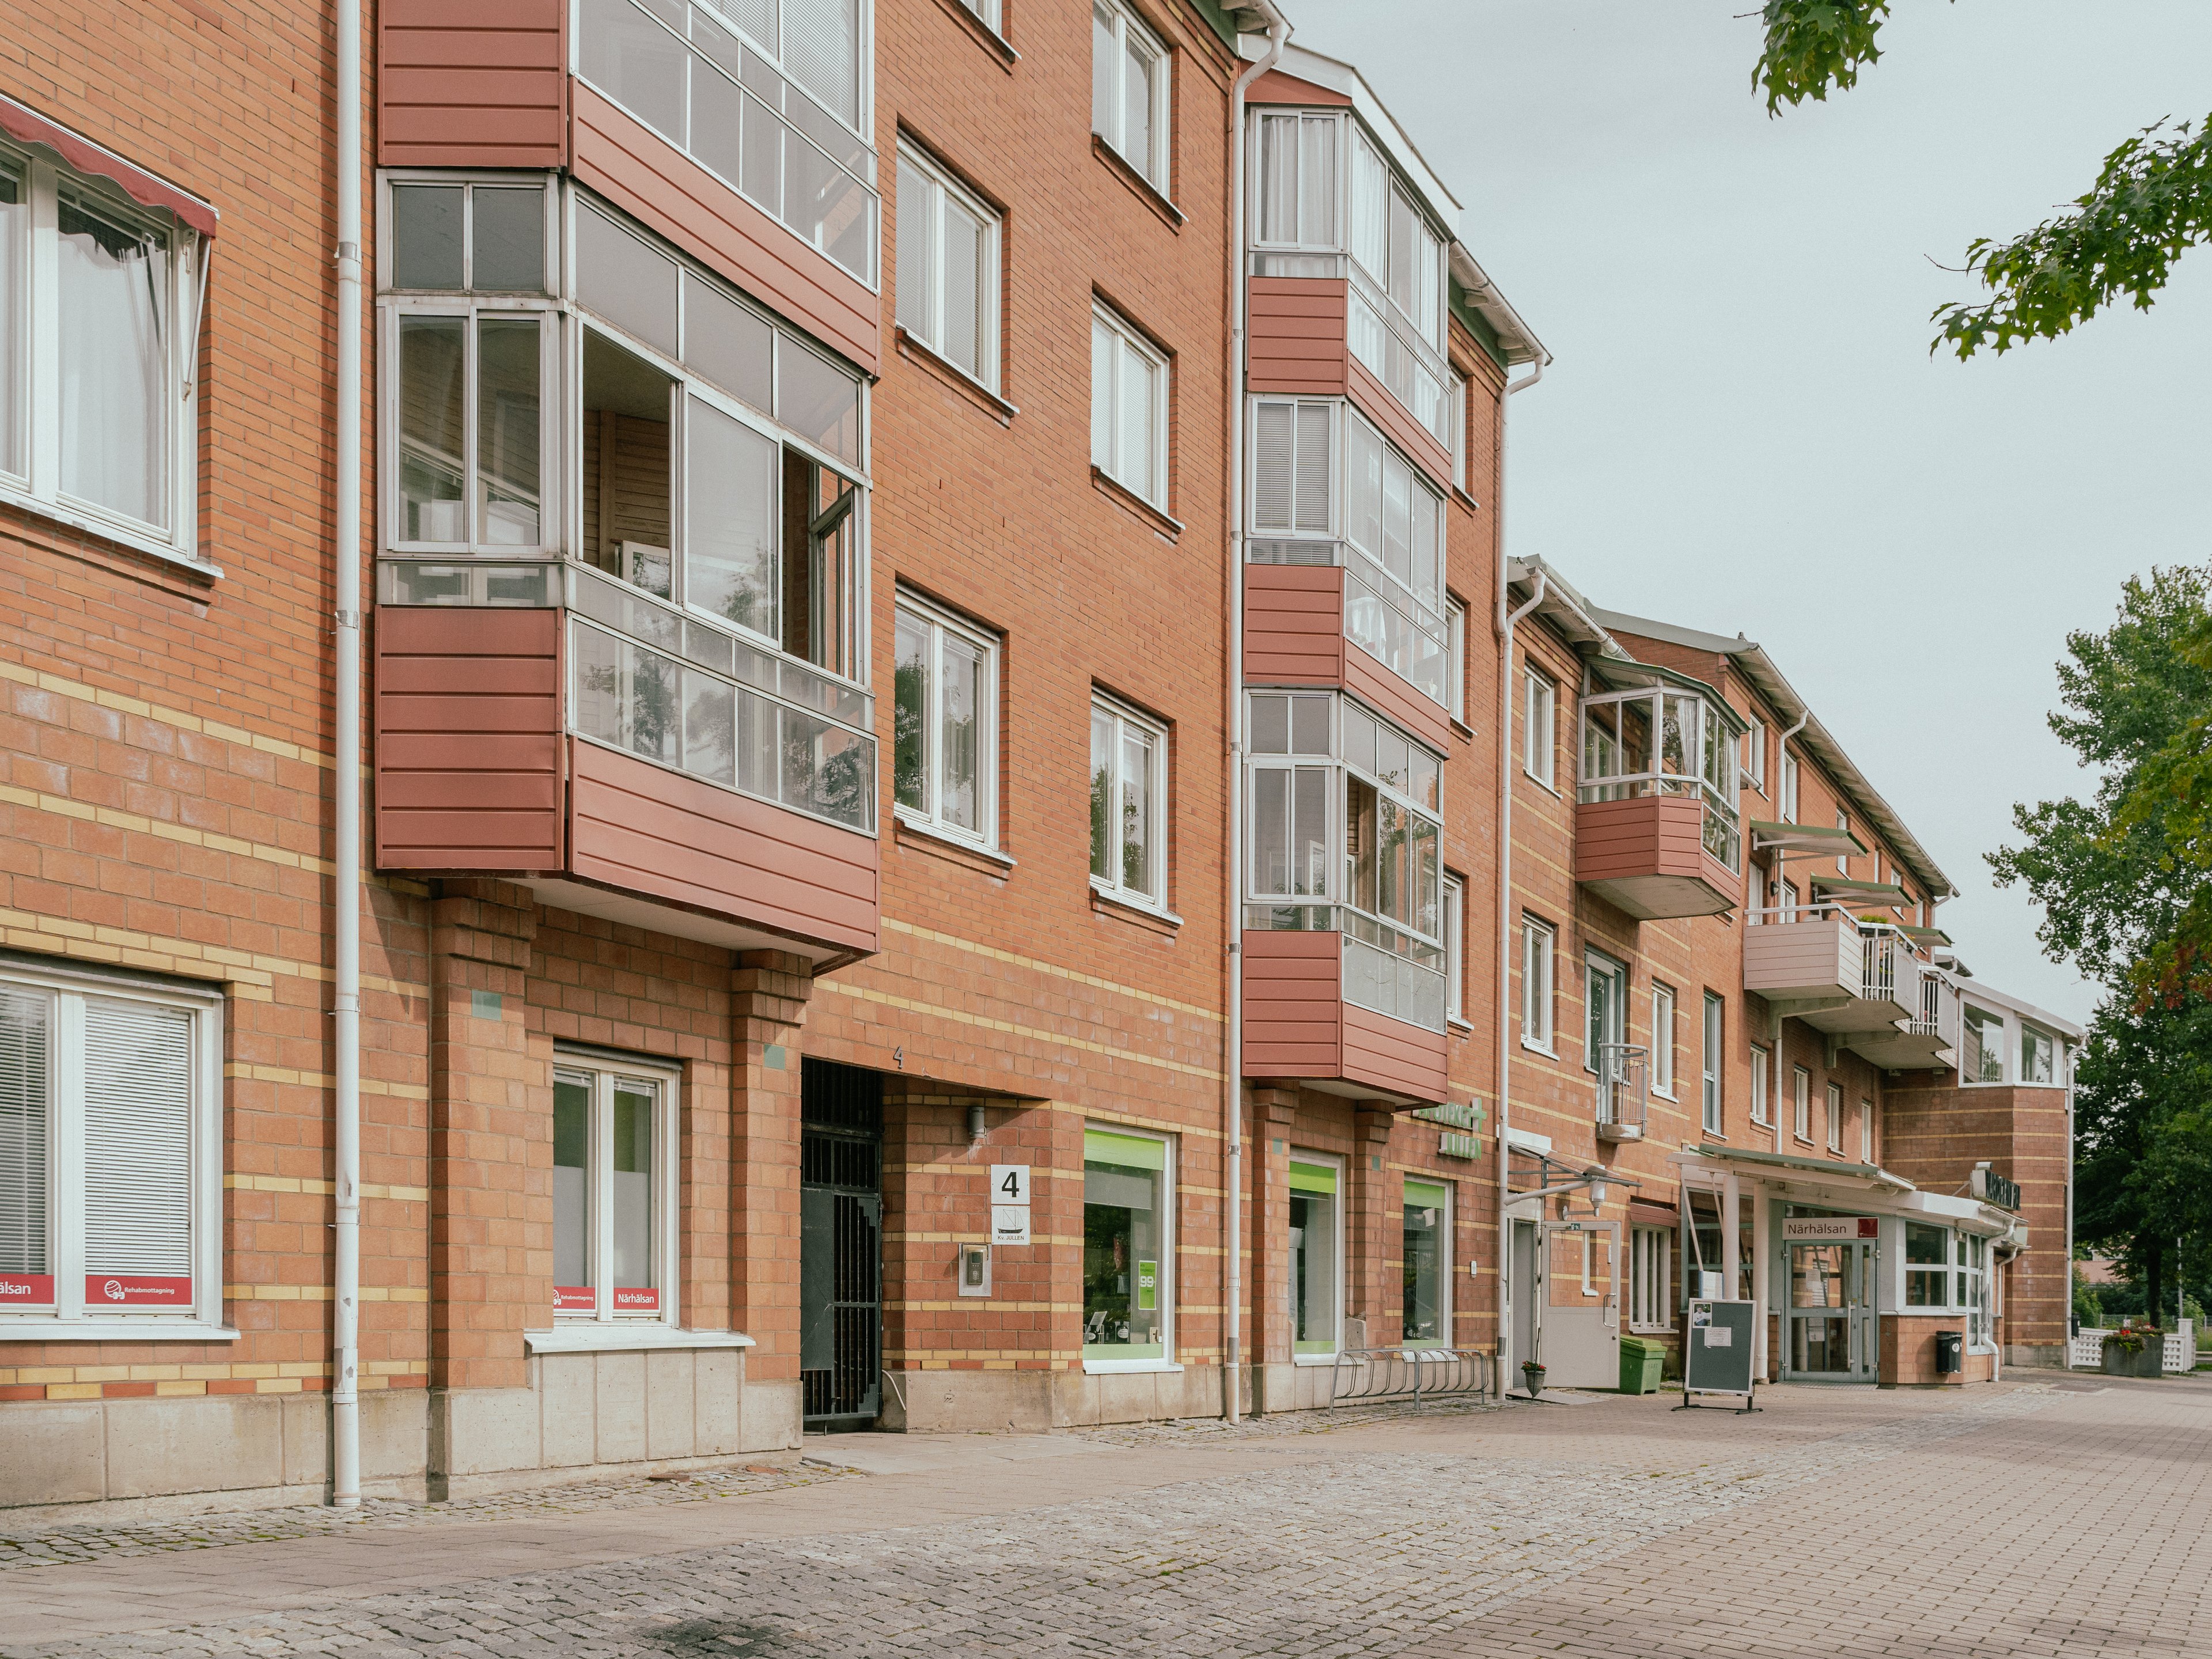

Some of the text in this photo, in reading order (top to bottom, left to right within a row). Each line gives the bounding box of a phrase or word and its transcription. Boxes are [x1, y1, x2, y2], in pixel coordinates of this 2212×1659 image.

[893, 1046, 903, 1069] 4
[1439, 1132, 1482, 1161] JULLEN
[1001, 1172, 1020, 1198] 4
[1788, 1224, 1847, 1234] Närhälsan
[124, 1287, 175, 1295] Rehabmottagning
[618, 1293, 654, 1304] Närhälsan
